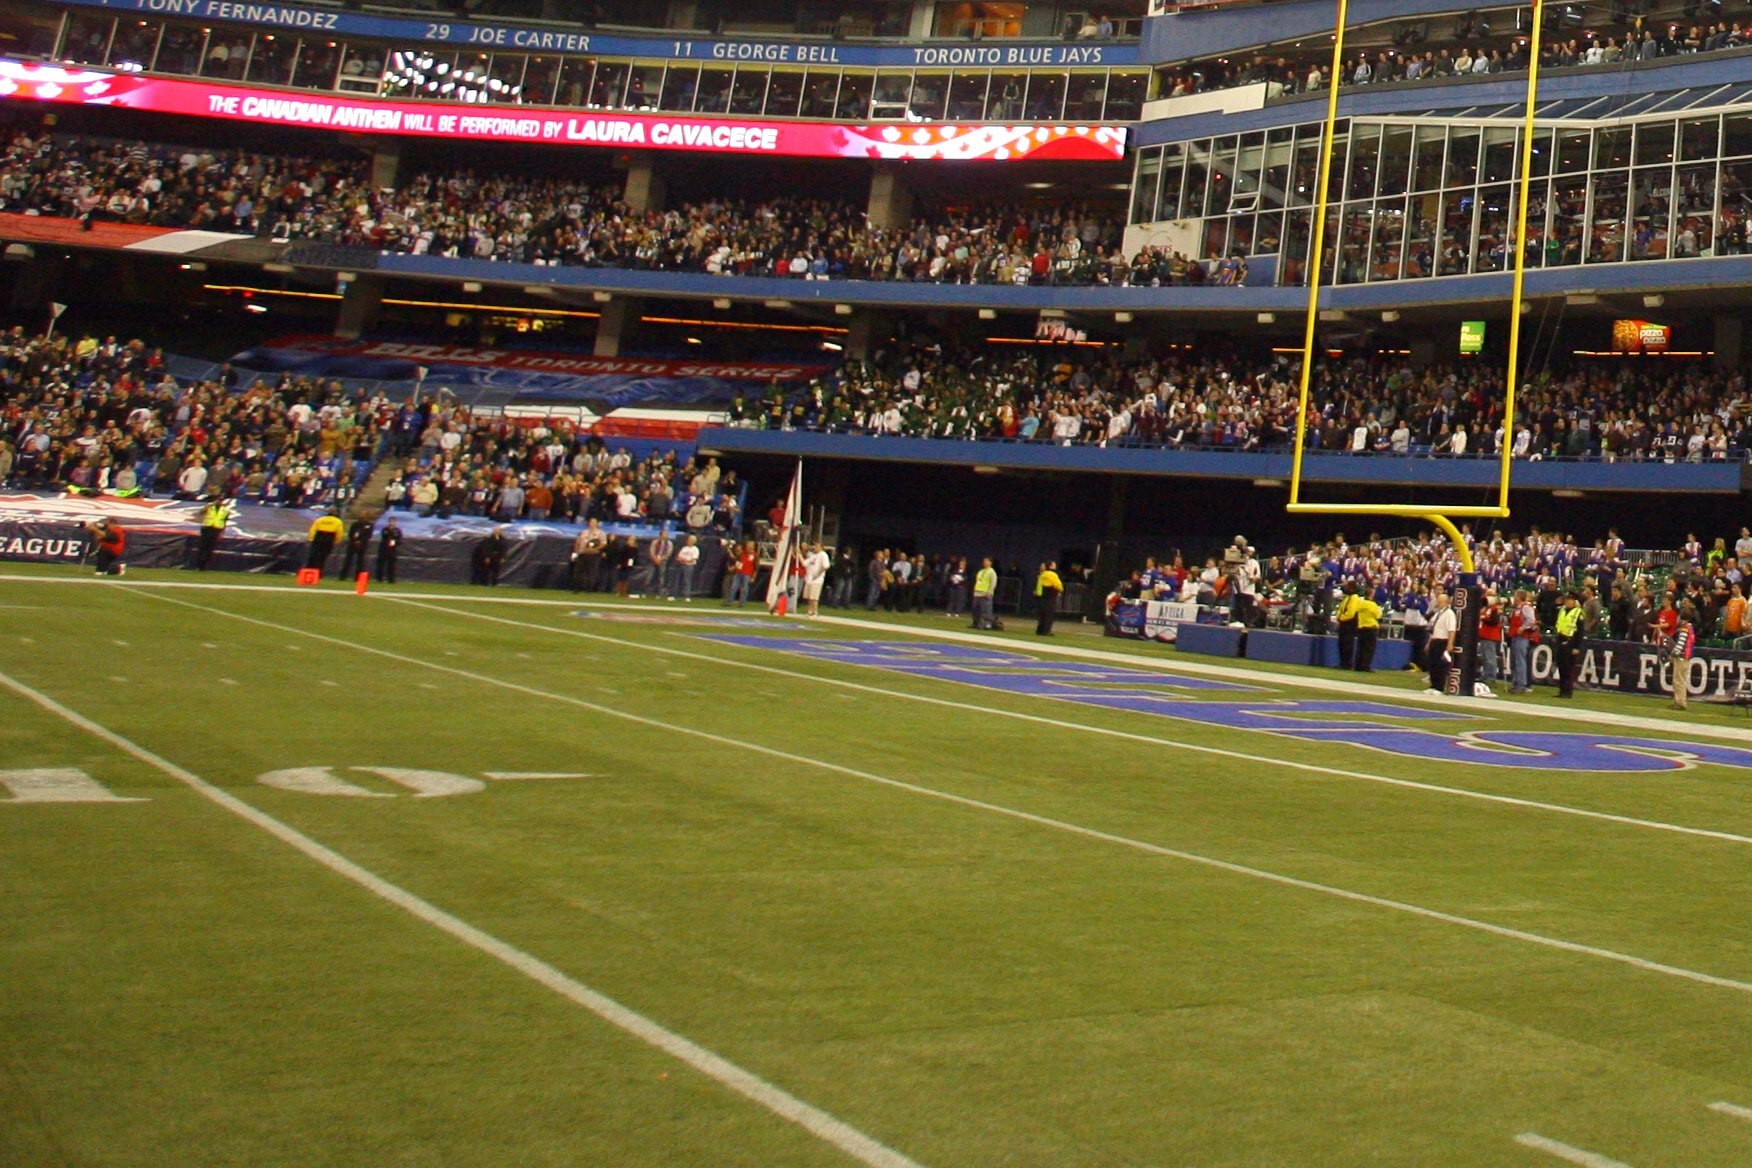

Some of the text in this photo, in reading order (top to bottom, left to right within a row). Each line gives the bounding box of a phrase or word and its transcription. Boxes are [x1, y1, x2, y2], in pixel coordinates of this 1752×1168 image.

[206, 1, 339, 29] FERNANDEZ
[425, 24, 450, 40] 29
[469, 28, 506, 44] JOE
[514, 31, 590, 51] CARTER
[674, 42, 692, 57] 11
[713, 42, 788, 60] GEORGE
[797, 46, 840, 62] BELL
[914, 48, 1000, 63] TORONTO
[1007, 47, 1052, 63] BLUE
[1059, 47, 1101, 63] JAYS
[209, 95, 778, 150] THE CANADIAN ANTHEM WILL BE PERFORMED BY LAURA CAVACECE
[366, 342, 803, 378] BILLS TORONTO SERIES
